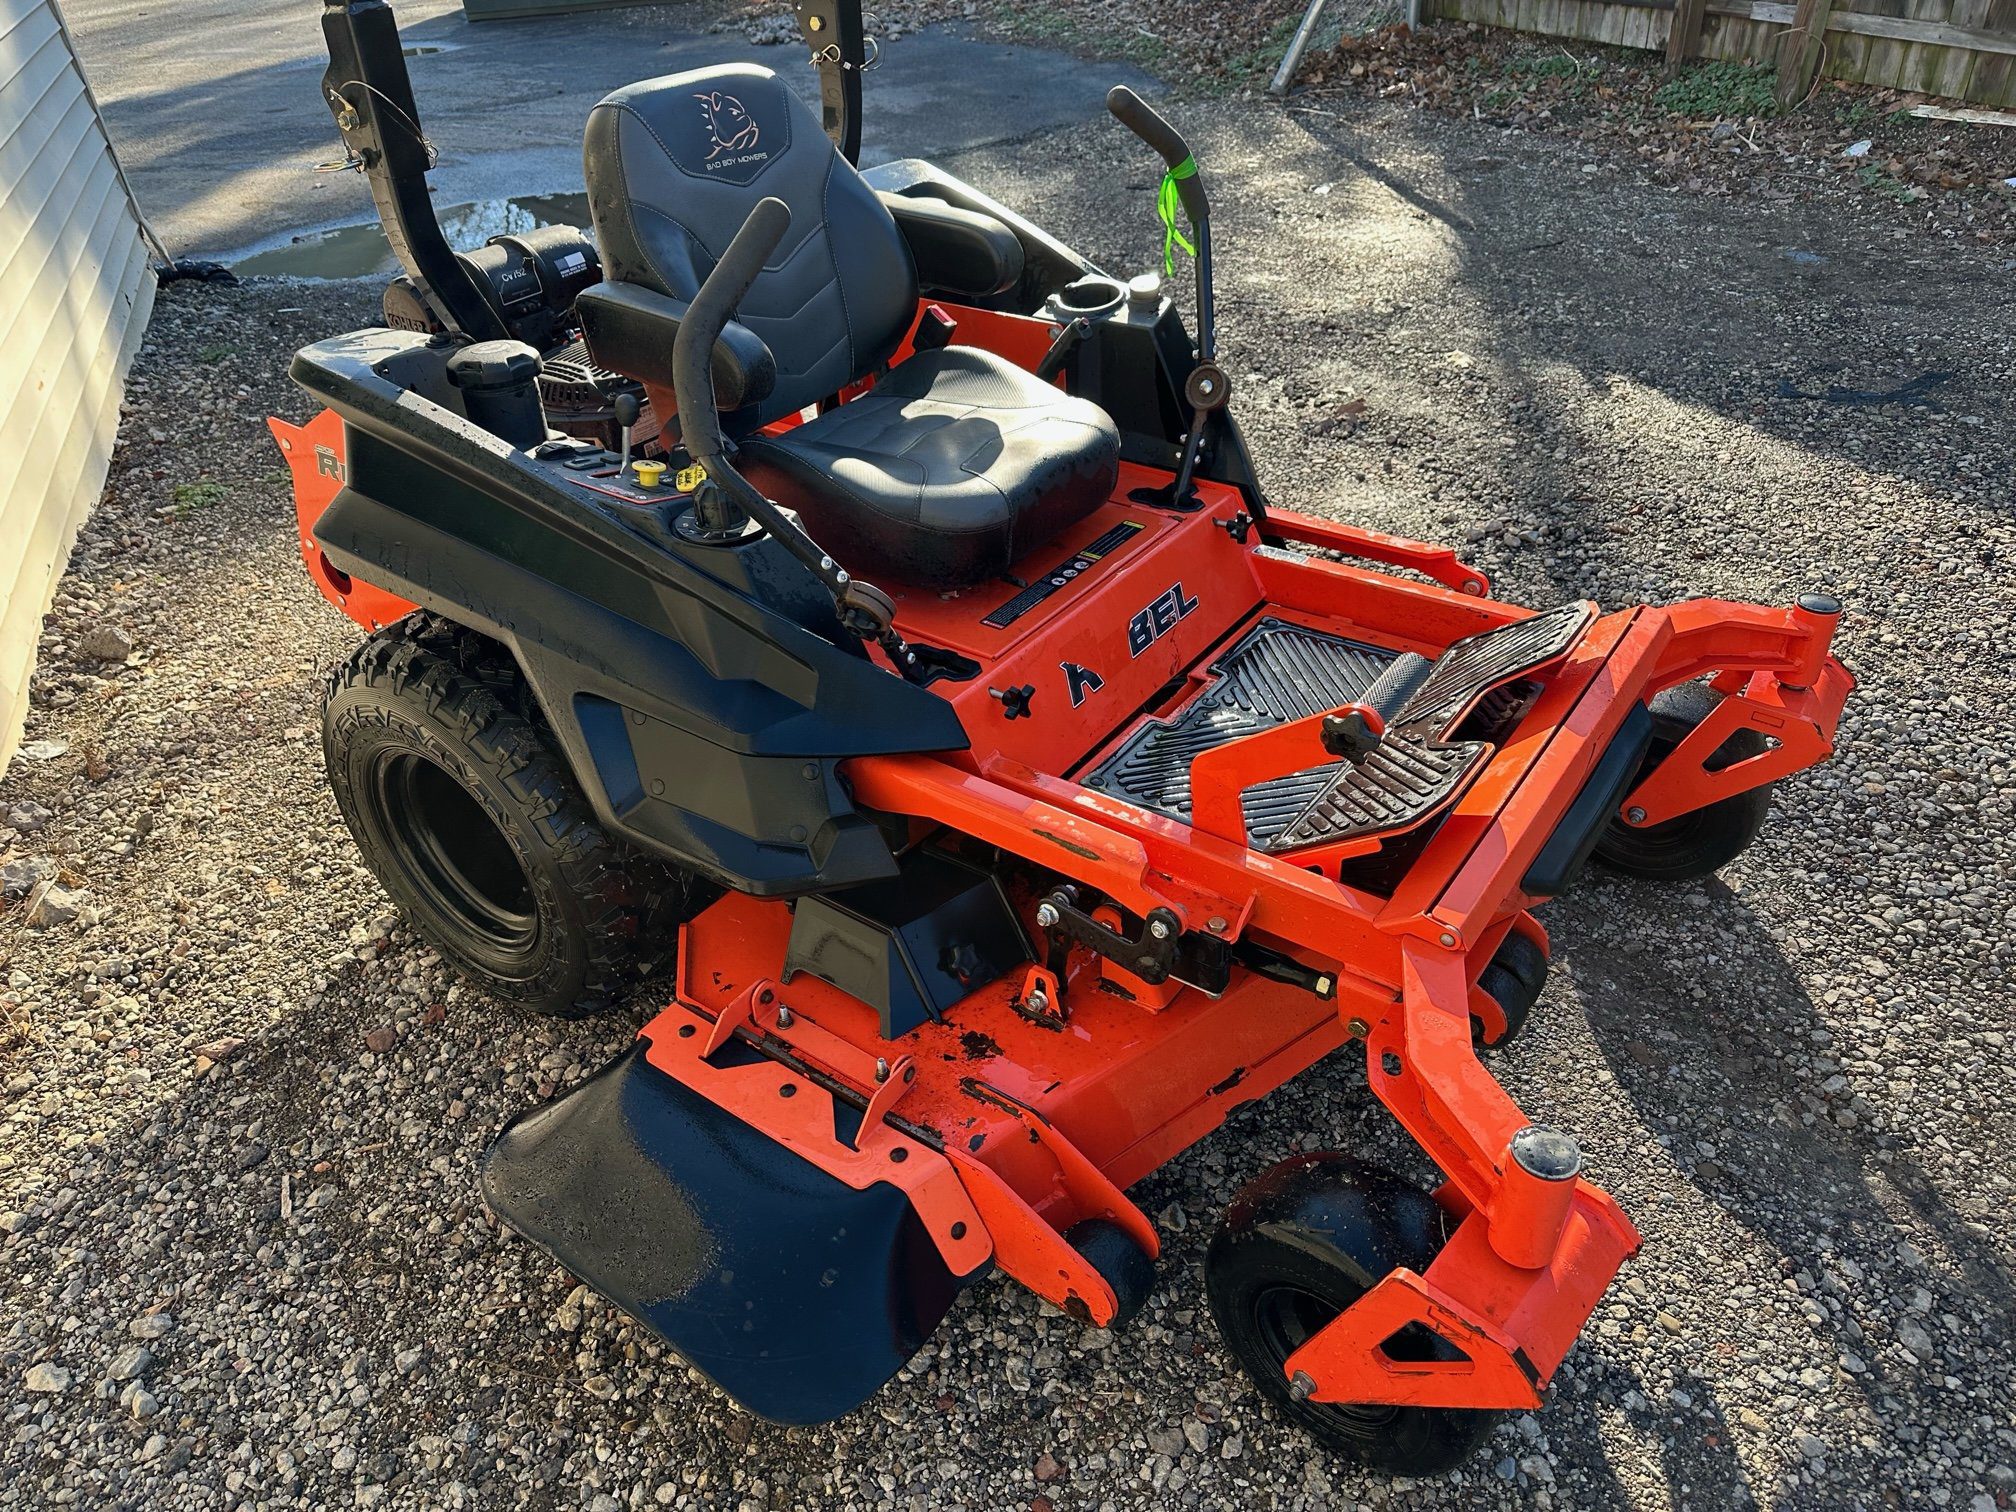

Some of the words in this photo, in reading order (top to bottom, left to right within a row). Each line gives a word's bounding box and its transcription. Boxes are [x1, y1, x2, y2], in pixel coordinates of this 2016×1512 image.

[706, 161, 721, 171] BAD
[722, 157, 738, 167] BOY
[738, 152, 768, 164] MOWERS
